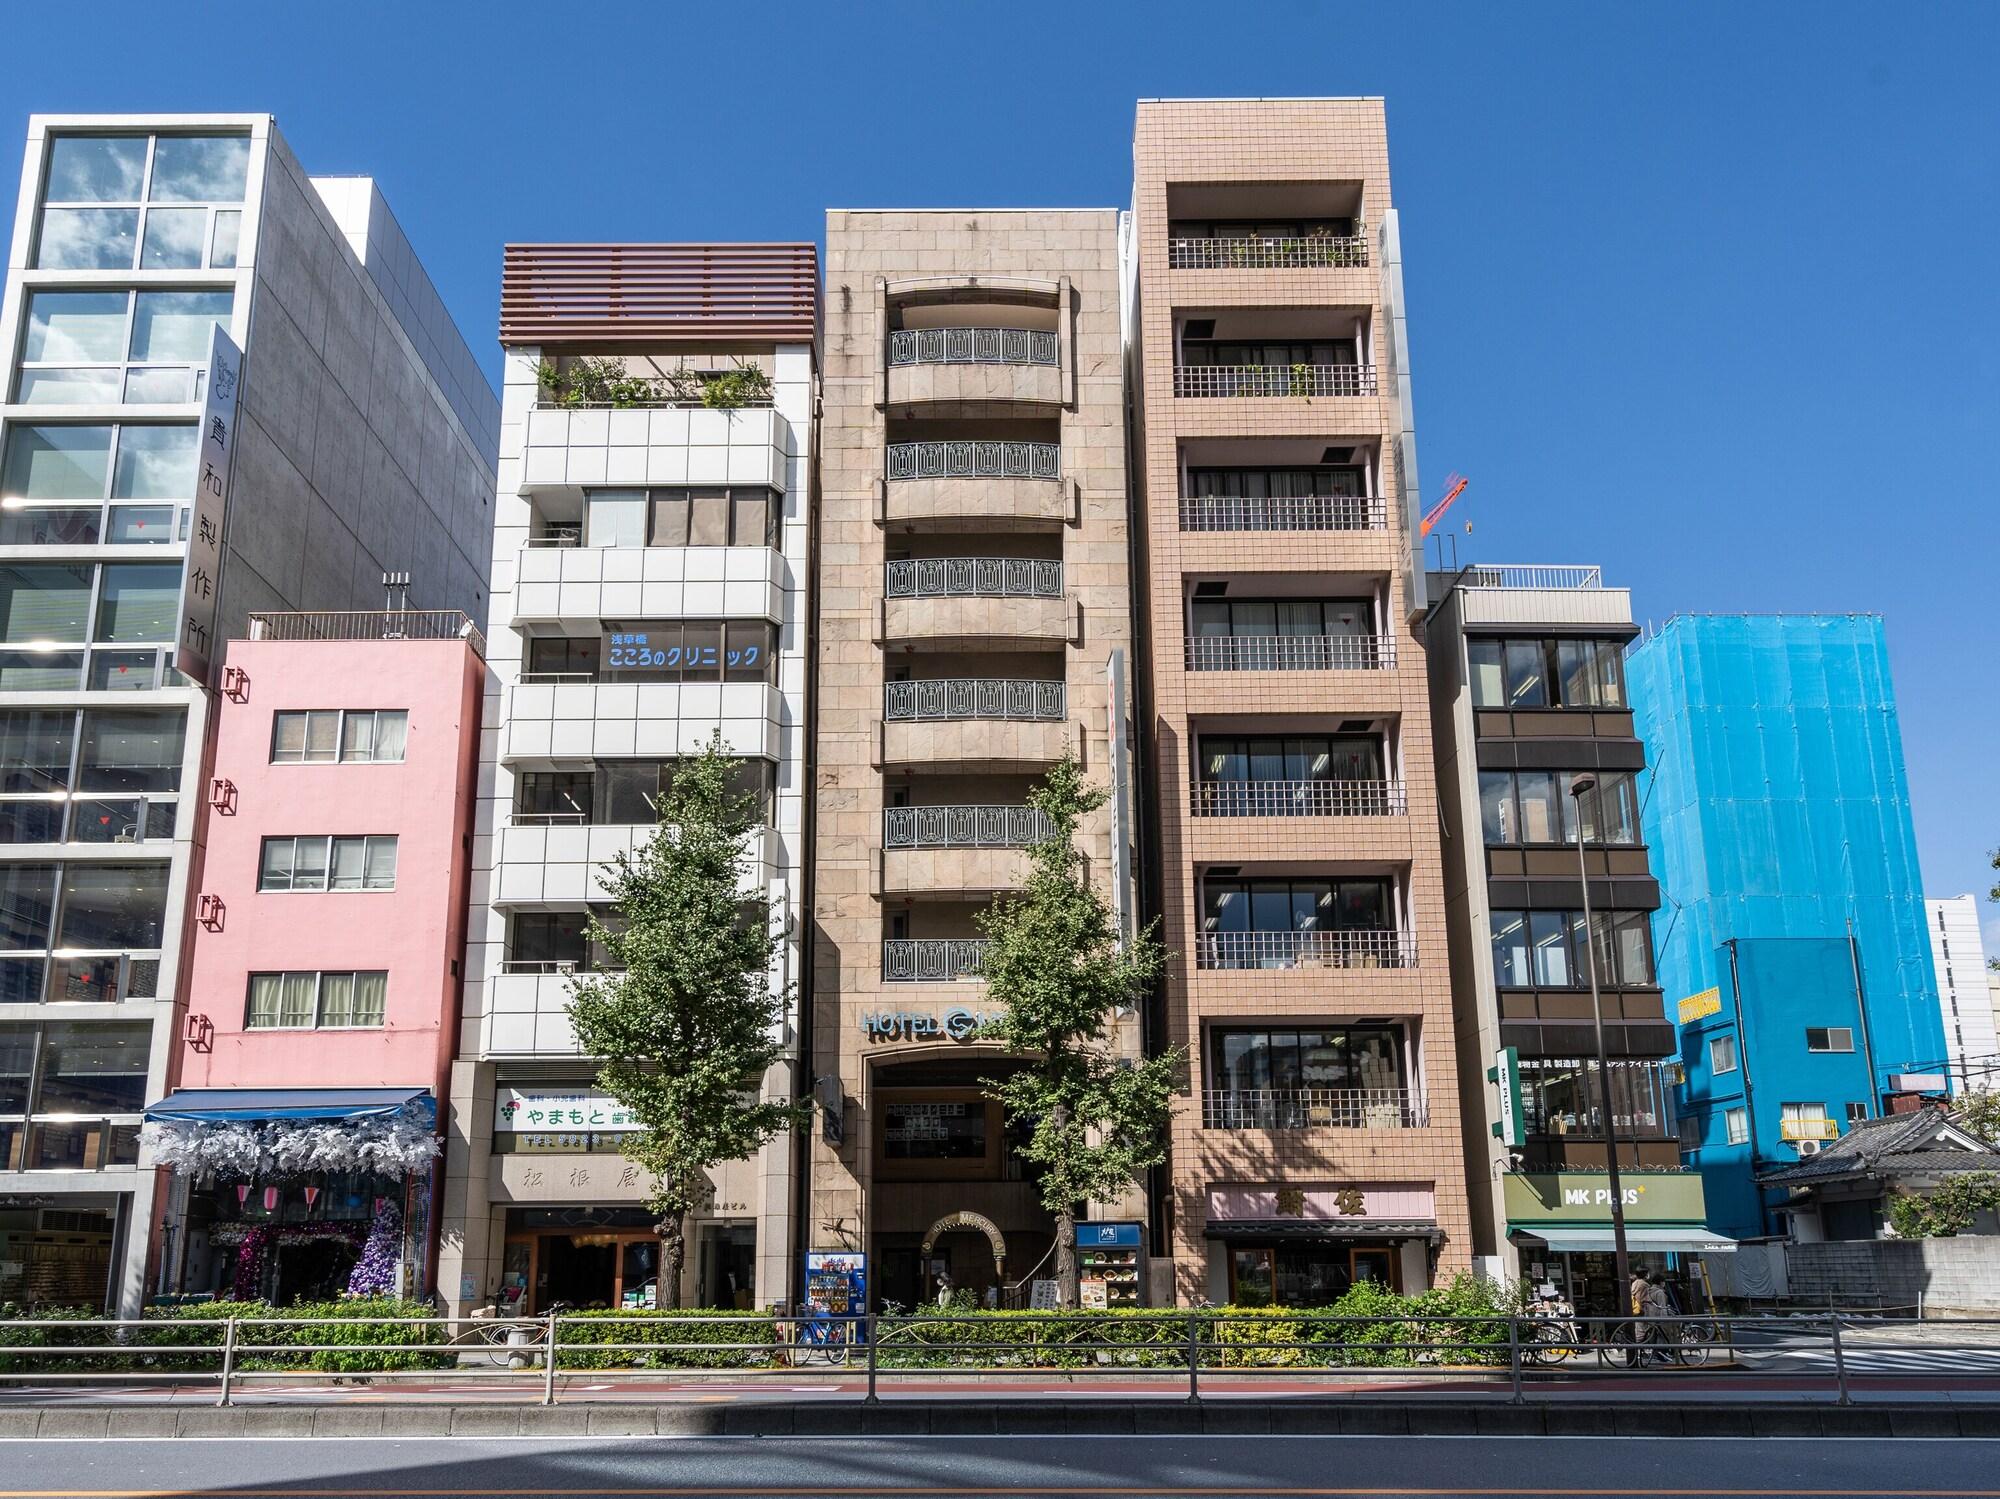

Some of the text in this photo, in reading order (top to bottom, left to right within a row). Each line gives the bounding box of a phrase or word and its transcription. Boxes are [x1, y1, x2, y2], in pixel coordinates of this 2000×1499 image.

[187, 414, 227, 654] 貴和製作所
[611, 633, 647, 645] 浅草橋
[609, 647, 758, 666] こころのクリニック
[861, 1010, 940, 1034] HOTEL
[523, 1134, 552, 1144] TEL
[1565, 1189, 1590, 1205] MK
[960, 1213, 998, 1235] MERCURY
